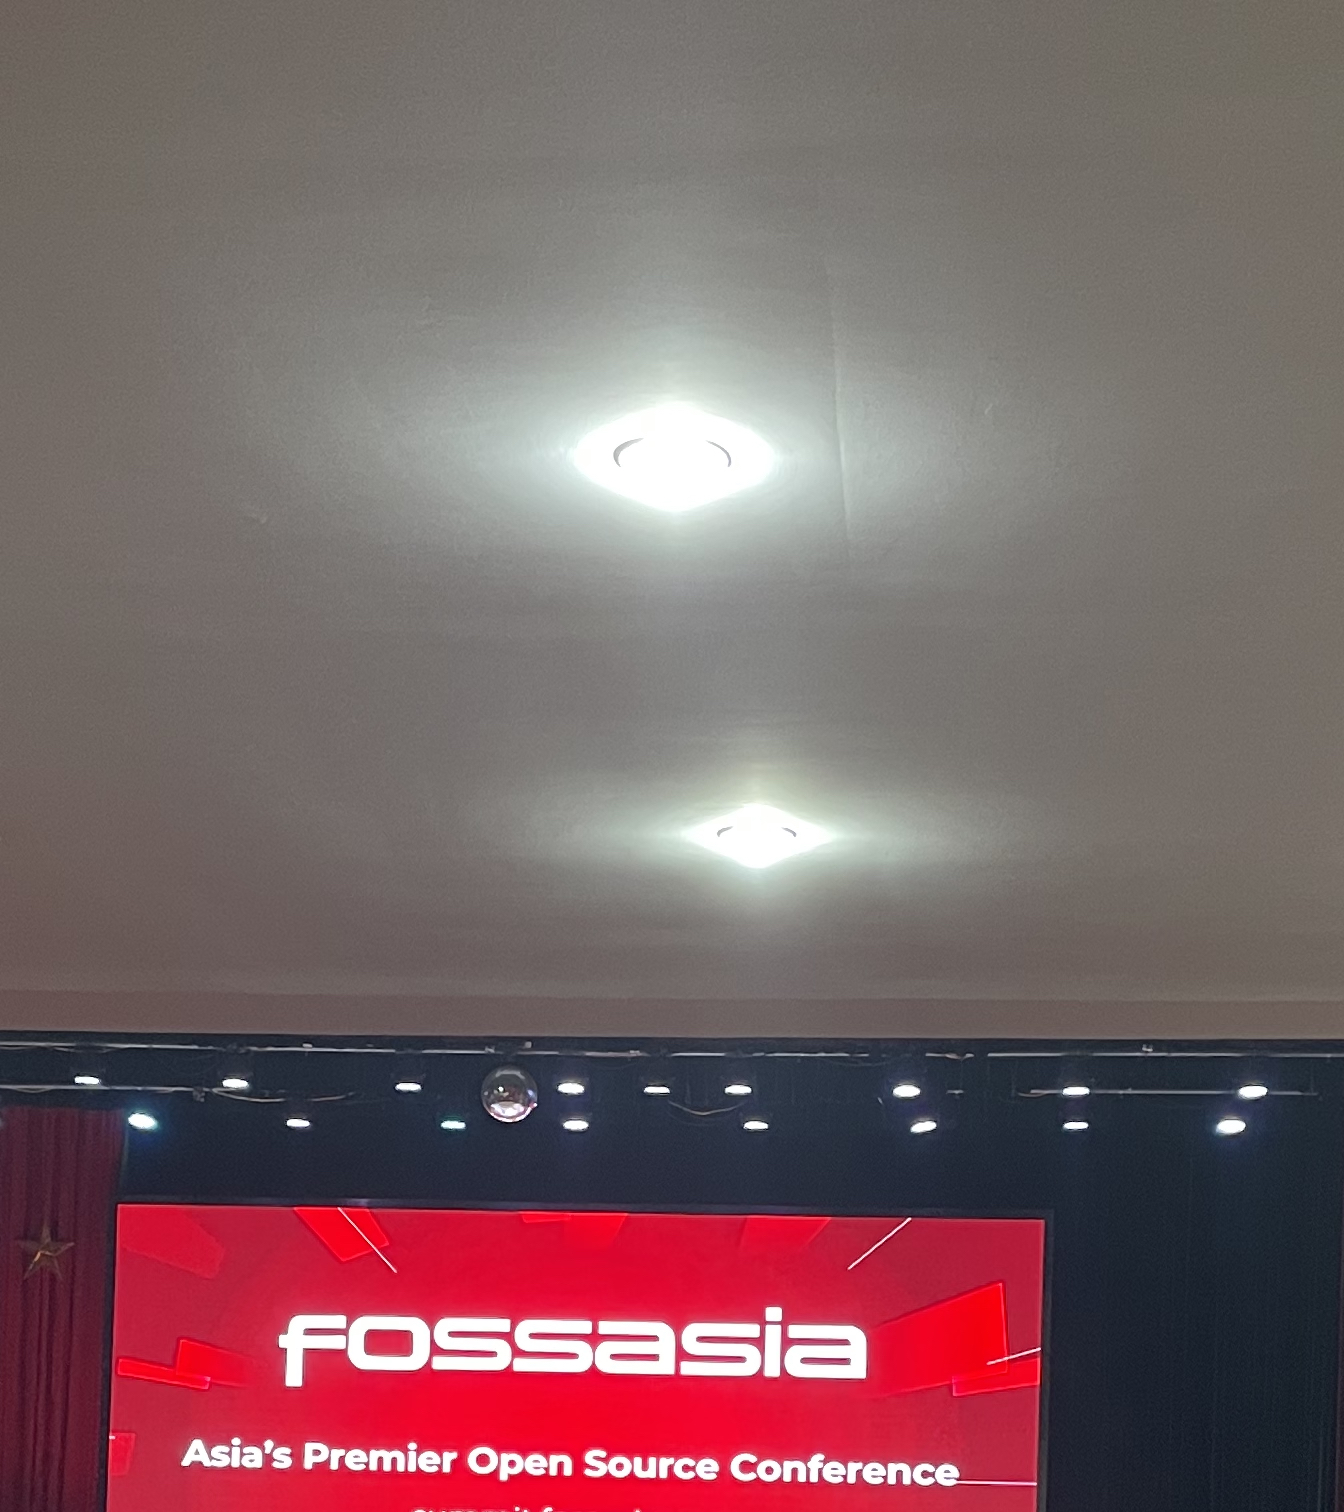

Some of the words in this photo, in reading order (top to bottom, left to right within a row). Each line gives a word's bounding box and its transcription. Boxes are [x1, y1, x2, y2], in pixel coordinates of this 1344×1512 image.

[278, 1306, 868, 1388] fossasia
[303, 1442, 458, 1474] Premier
[467, 1446, 573, 1482] Open
[583, 1449, 720, 1482] Source
[729, 1453, 960, 1487] Conference
